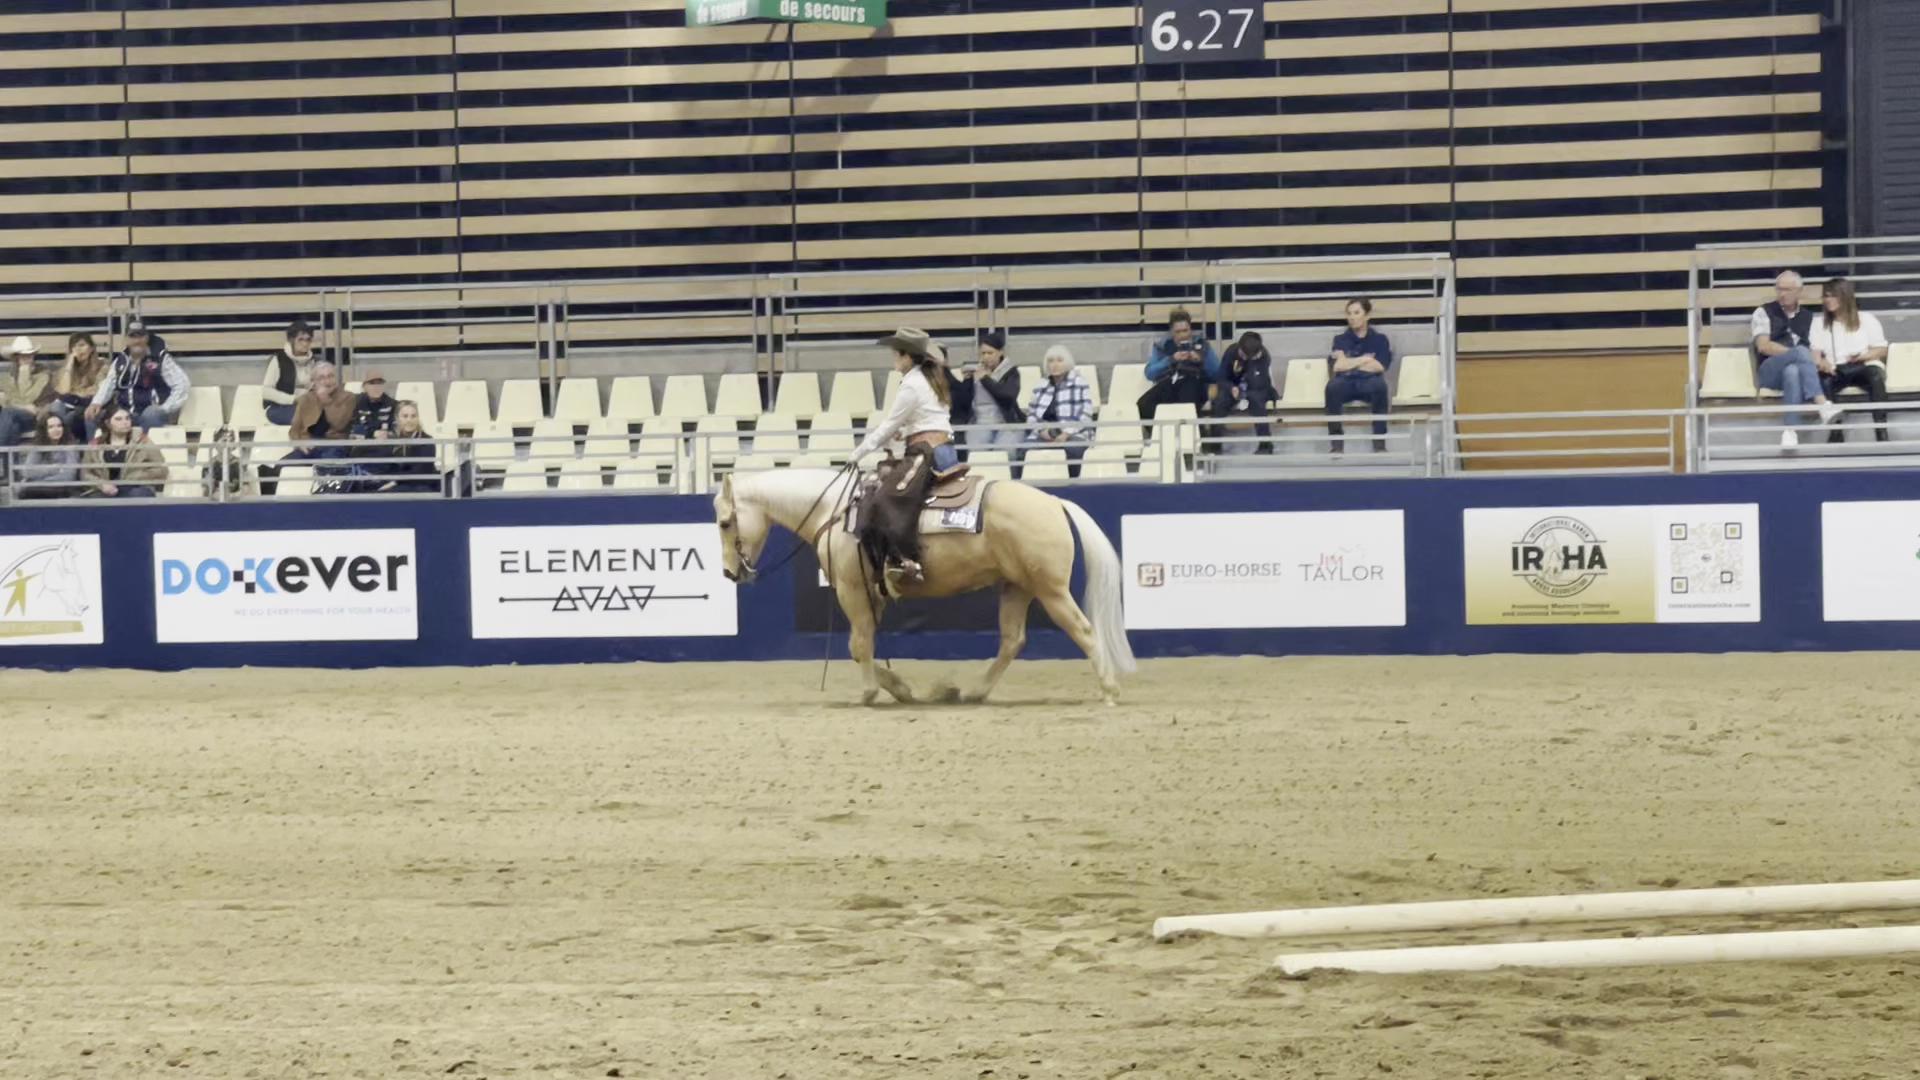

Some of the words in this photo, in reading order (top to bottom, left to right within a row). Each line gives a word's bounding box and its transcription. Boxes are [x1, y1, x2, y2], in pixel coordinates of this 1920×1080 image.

[779, 0, 798, 17] de
[804, 2, 865, 23] secours
[1151, 8, 1254, 51] 6.27
[500, 548, 705, 573] ELEMENTA
[1170, 562, 1282, 578] EURO-HORSE
[1298, 563, 1384, 582] TAYLOR
